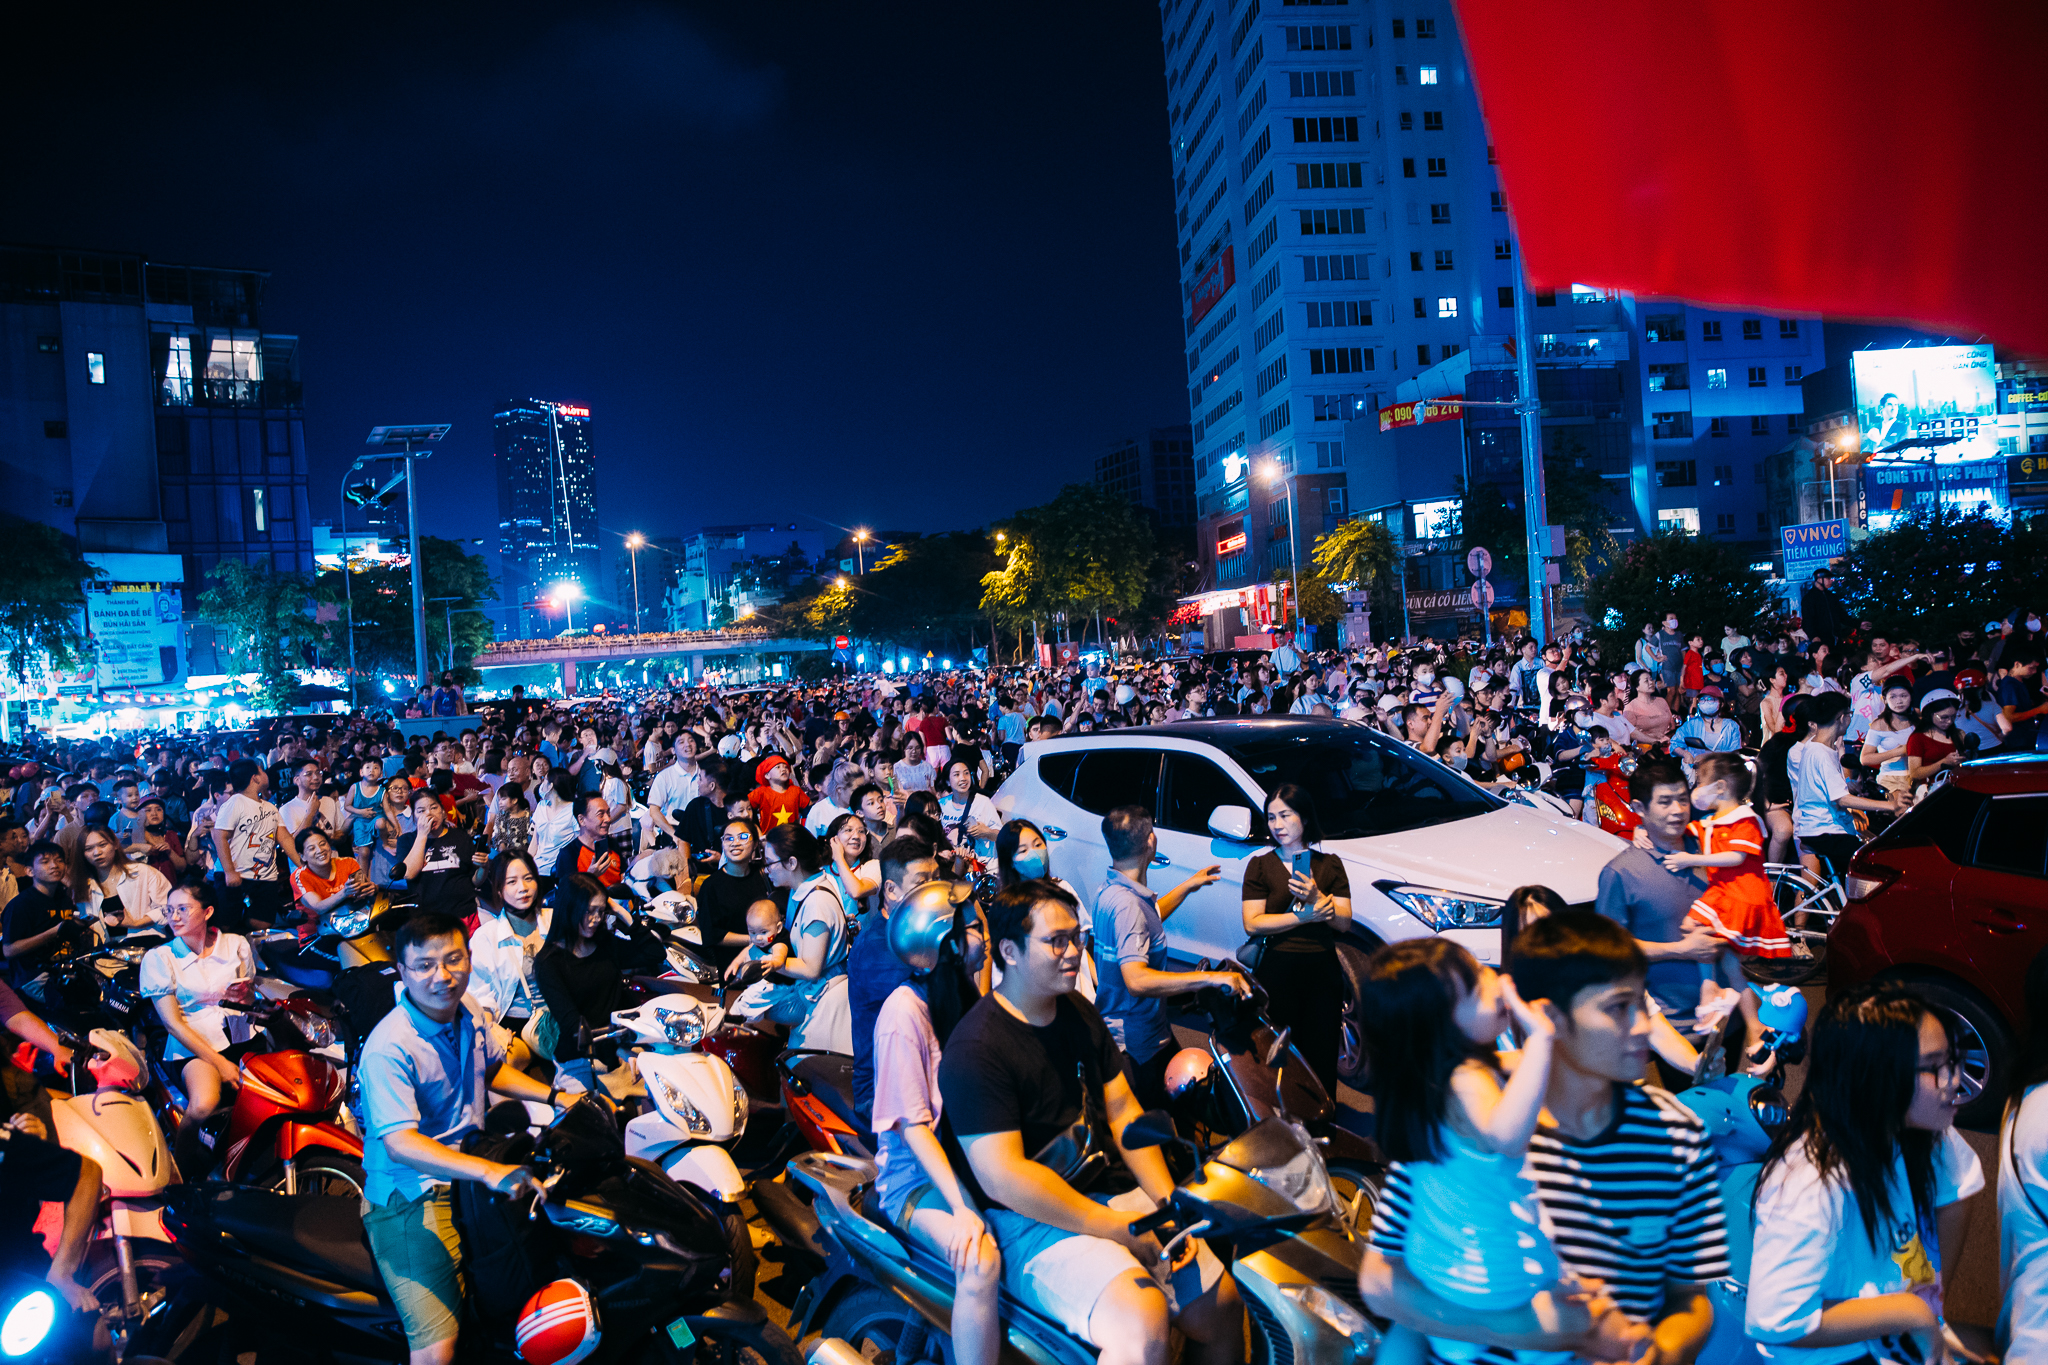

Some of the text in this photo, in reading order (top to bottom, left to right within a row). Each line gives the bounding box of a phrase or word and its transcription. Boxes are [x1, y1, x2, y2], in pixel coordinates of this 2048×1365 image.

[567, 407, 590, 417] LOTTE
[1394, 406, 1412, 422] 090
[1876, 468, 1909, 485] CÔNG
[1912, 469, 1926, 483] TY
[1858, 481, 1867, 520] LONG
[1939, 487, 1993, 503] PHARMA
[1798, 524, 1841, 542] VNVC
[1786, 545, 1808, 560] TIÊM
[1423, 592, 1437, 609] CÁ
[1437, 591, 1451, 608] CÔ
[94, 609, 118, 618] BÁNH
[109, 998, 130, 1014] YAMAHA
